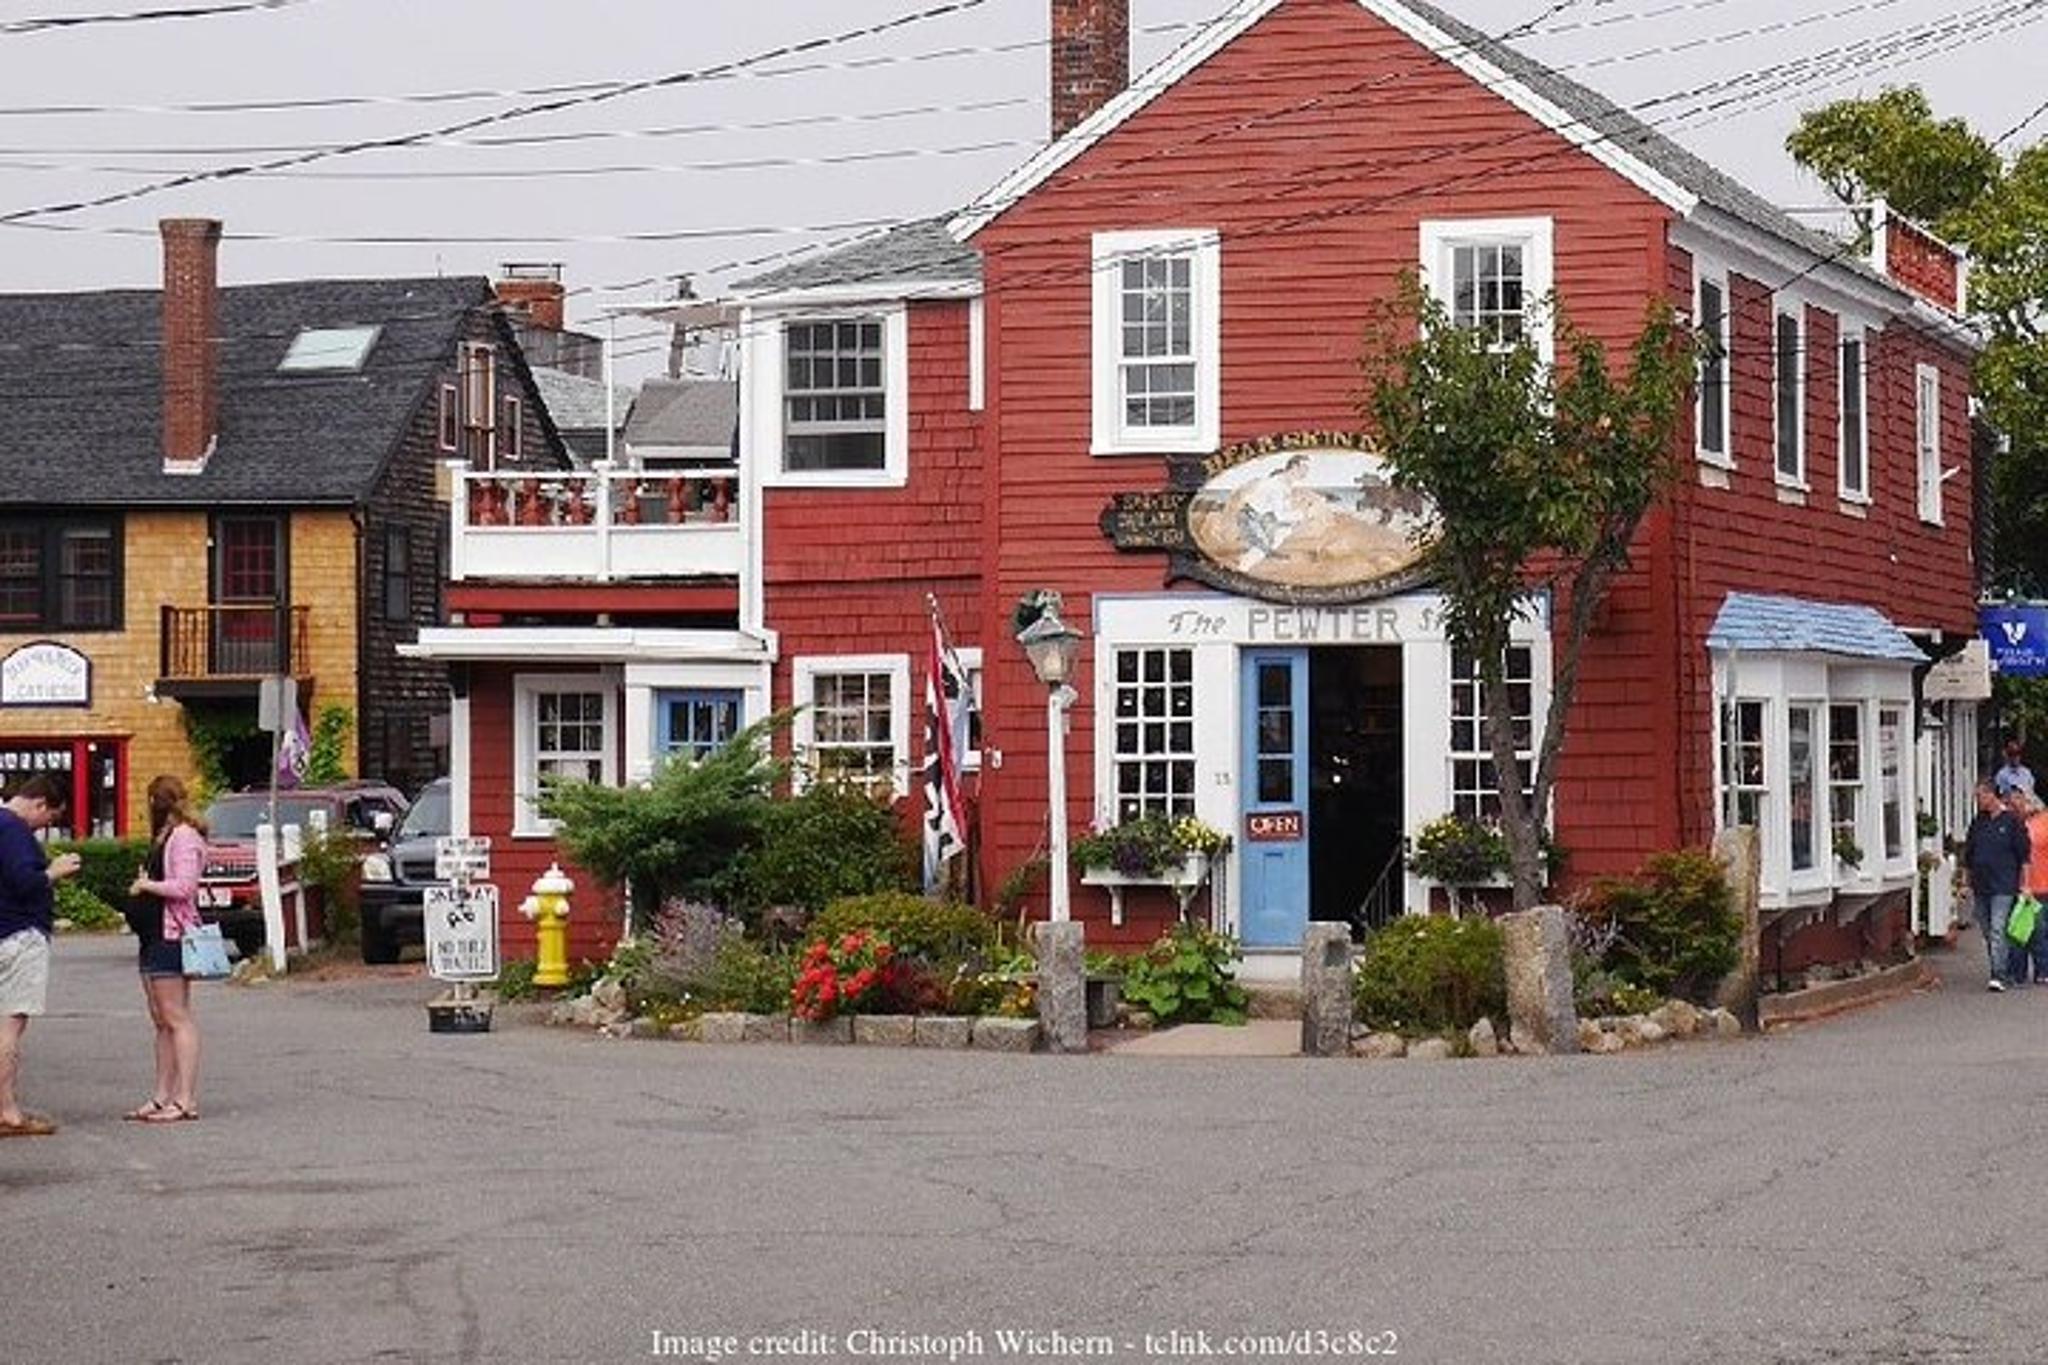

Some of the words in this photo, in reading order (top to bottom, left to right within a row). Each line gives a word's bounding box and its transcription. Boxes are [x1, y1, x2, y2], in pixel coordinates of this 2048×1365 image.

[1168, 610, 1226, 635] The
[1248, 608, 1400, 640] PEWTER
[1250, 816, 1299, 834] OPEN
